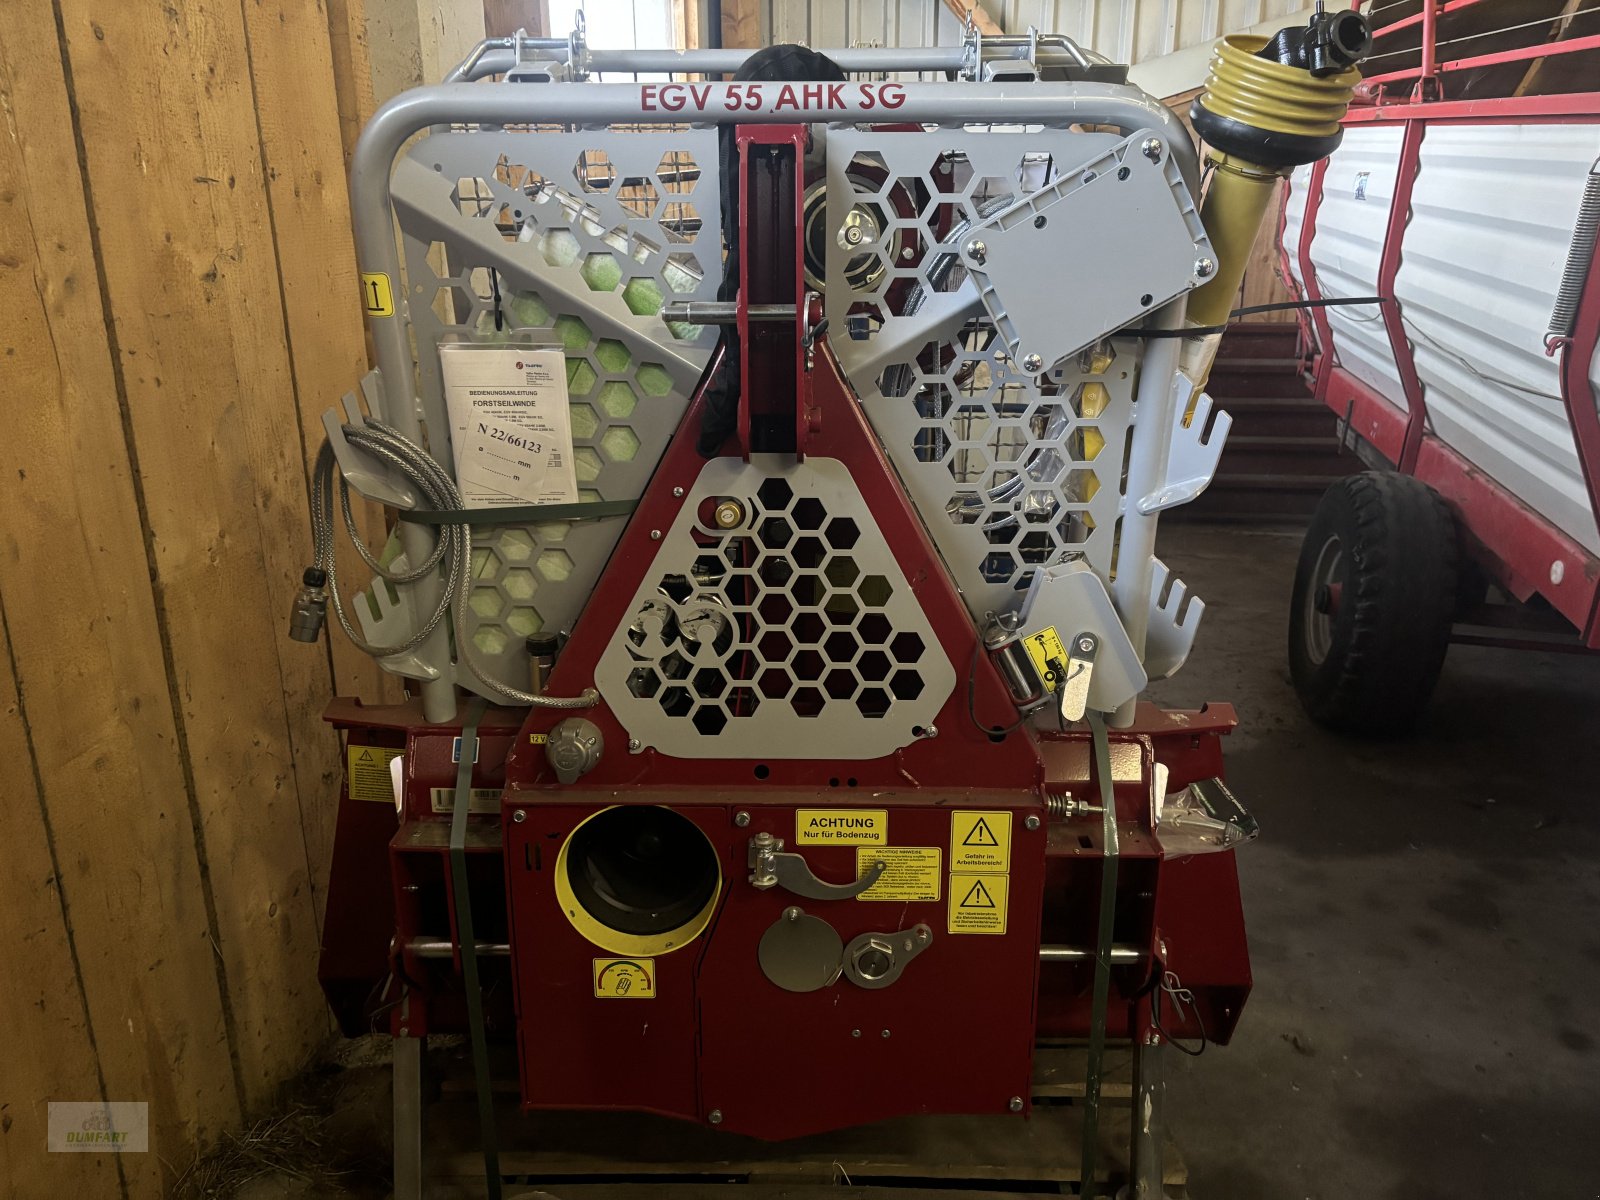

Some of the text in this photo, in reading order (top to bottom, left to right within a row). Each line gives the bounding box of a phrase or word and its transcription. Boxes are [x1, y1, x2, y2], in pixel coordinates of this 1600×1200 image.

[642, 83, 906, 112] EGV 55 AHK SG
[477, 422, 543, 454] N 22/66123
[809, 817, 874, 828] ACHTUNG
[821, 830, 834, 838] für
[836, 830, 880, 840] Bodenzug
